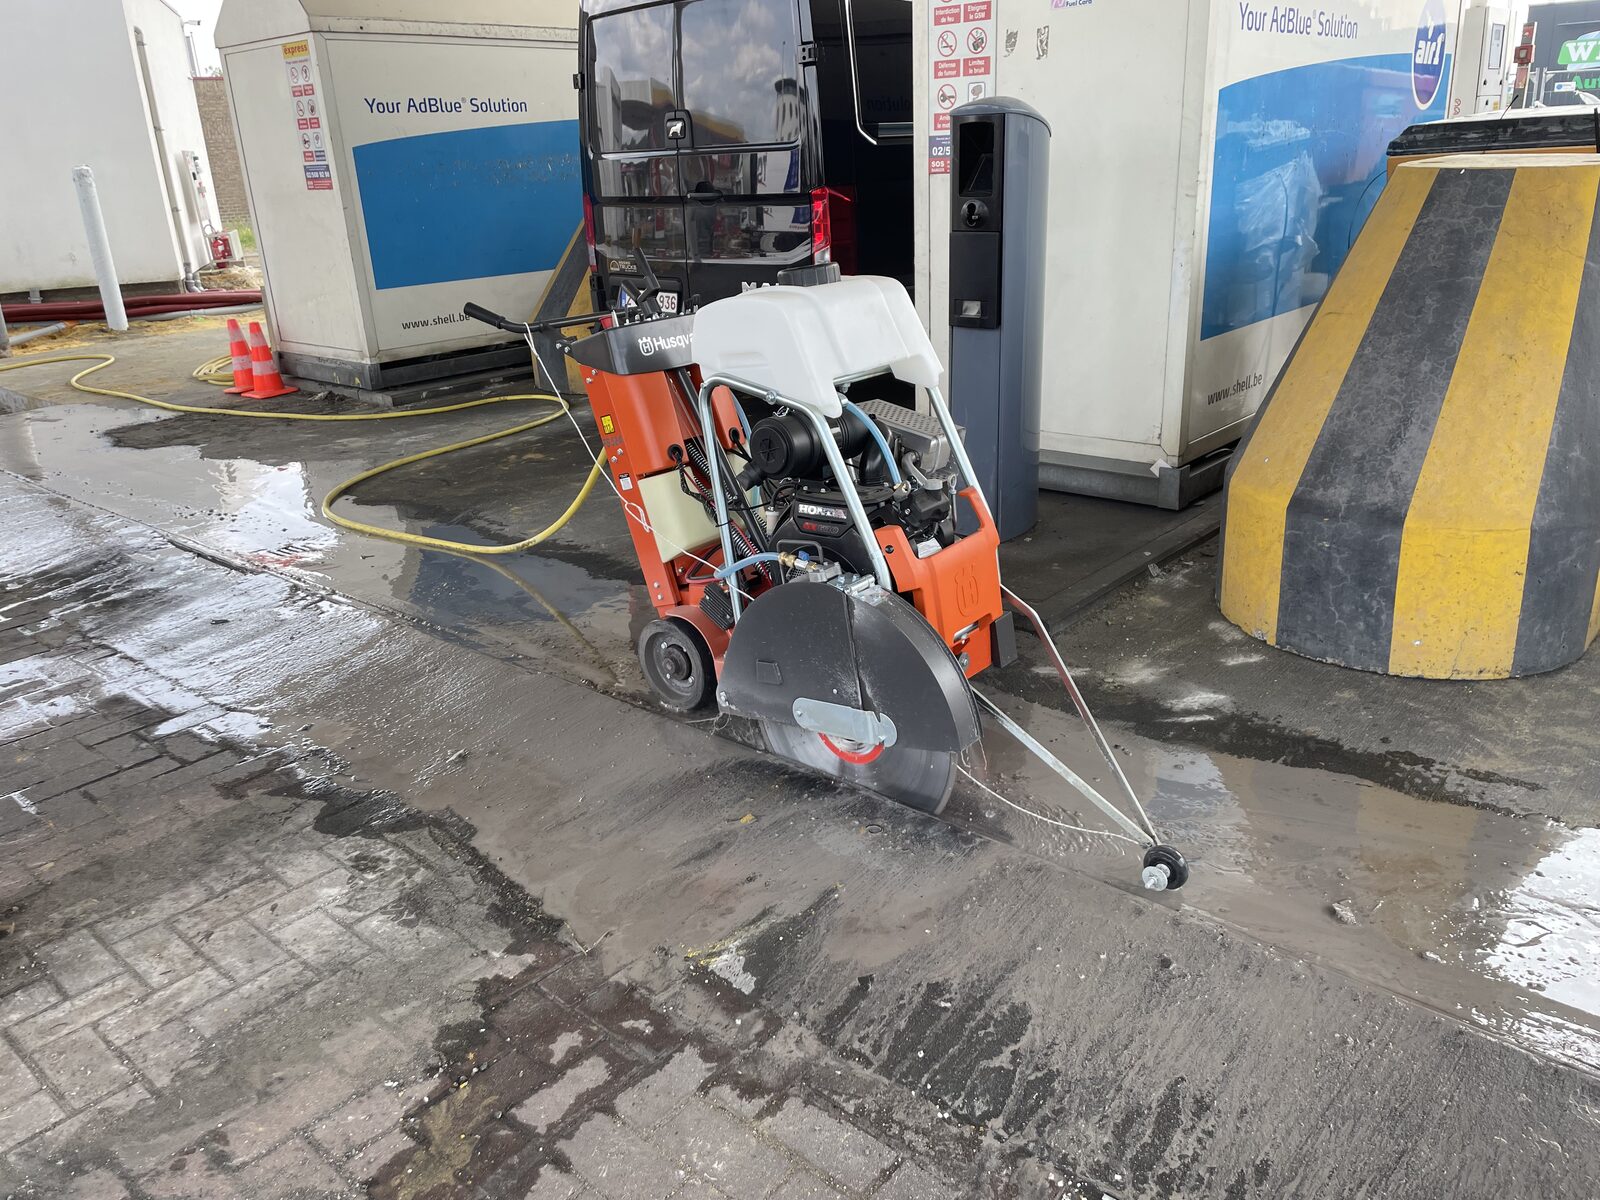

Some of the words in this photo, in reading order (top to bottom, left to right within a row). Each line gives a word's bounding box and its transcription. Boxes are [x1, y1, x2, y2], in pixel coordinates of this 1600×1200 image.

[1239, 2, 1267, 31] Your
[1317, 11, 1358, 39] Solution
[283, 45, 308, 55] express
[364, 98, 401, 113] Your
[469, 97, 528, 113] Solution
[931, 160, 945, 168] SOS
[401, 312, 471, 330] www.shell.be
[1207, 372, 1263, 406] www.shell.be
